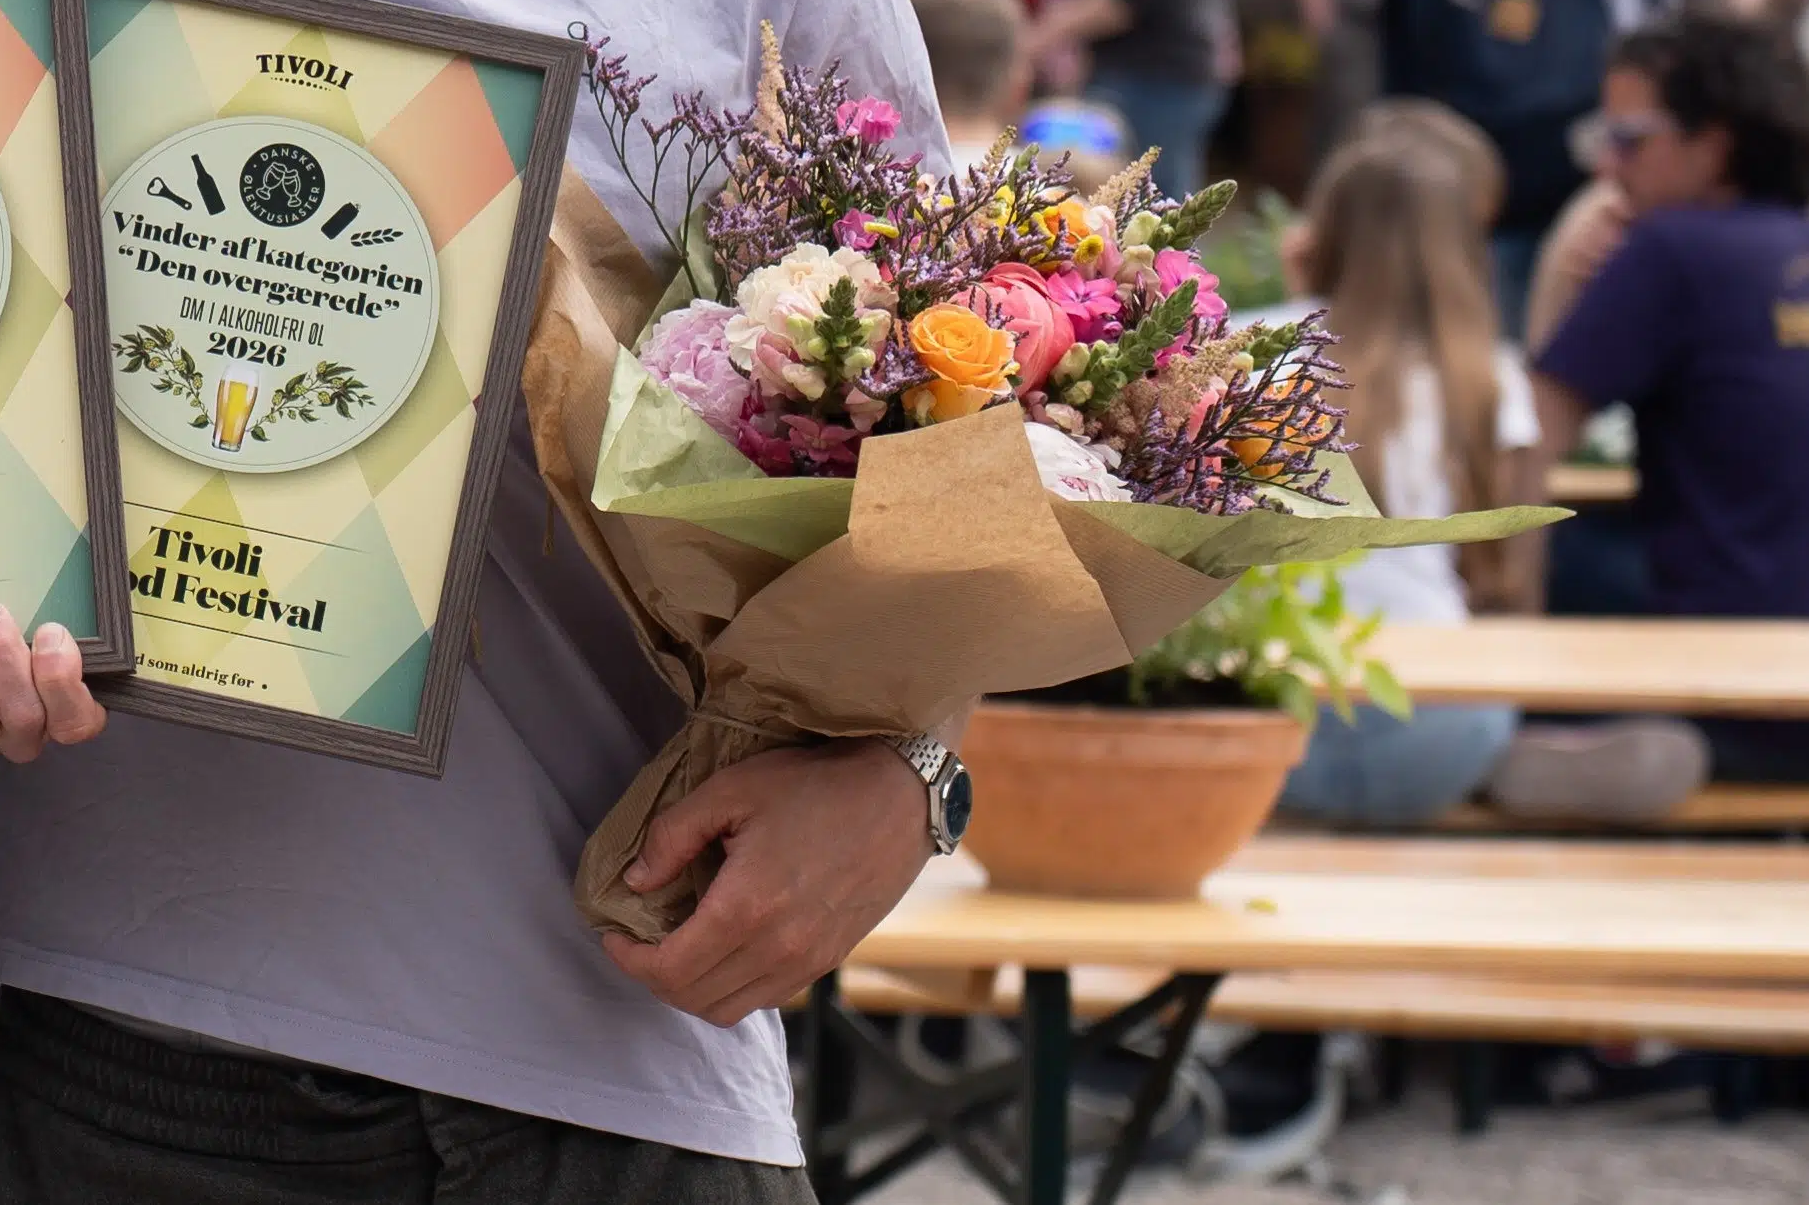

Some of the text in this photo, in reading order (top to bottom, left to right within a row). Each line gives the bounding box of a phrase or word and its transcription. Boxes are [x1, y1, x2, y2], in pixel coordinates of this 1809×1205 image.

[255, 54, 355, 91] TIVOLI
[259, 148, 316, 172] DANSKE
[243, 175, 321, 224] ØLENTUSIASTER
[113, 210, 424, 296] Vinder af kategorien
[202, 268, 400, 319] overgærede”
[179, 296, 327, 347] DM I ALKOHOLFRI ØL
[206, 331, 287, 368] 2026
[148, 525, 263, 579] Tivoli
[171, 572, 328, 634] Festival
[147, 657, 179, 673] som
[181, 663, 230, 687] aldrig
[231, 672, 255, 689] før
